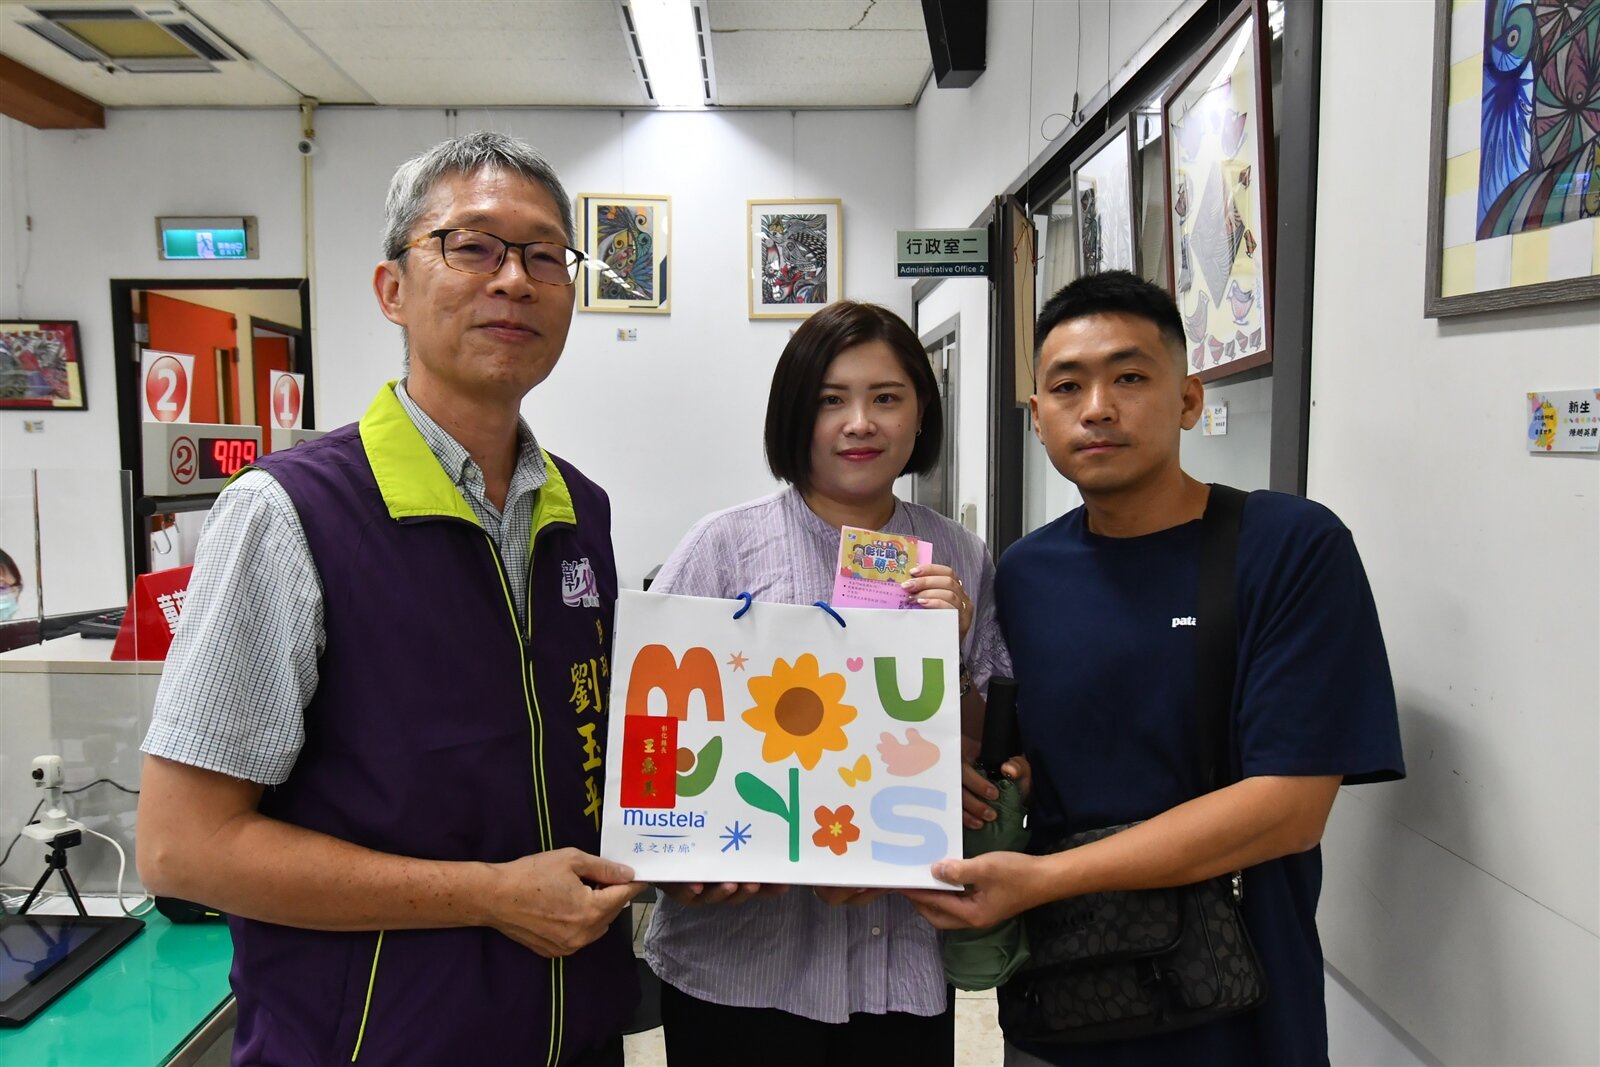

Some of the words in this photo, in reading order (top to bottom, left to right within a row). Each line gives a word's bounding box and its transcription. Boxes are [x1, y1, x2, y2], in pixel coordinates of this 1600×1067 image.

[906, 238, 979, 255] 行政室二
[900, 266, 953, 274] Administrative
[954, 265, 977, 273] Office
[979, 265, 985, 273] 2
[156, 368, 178, 411] 2
[279, 383, 293, 421] 1
[1568, 400, 1591, 414] 新生
[175, 444, 193, 476] 2
[213, 440, 256, 475] 909
[569, 658, 602, 833] 劉玉平
